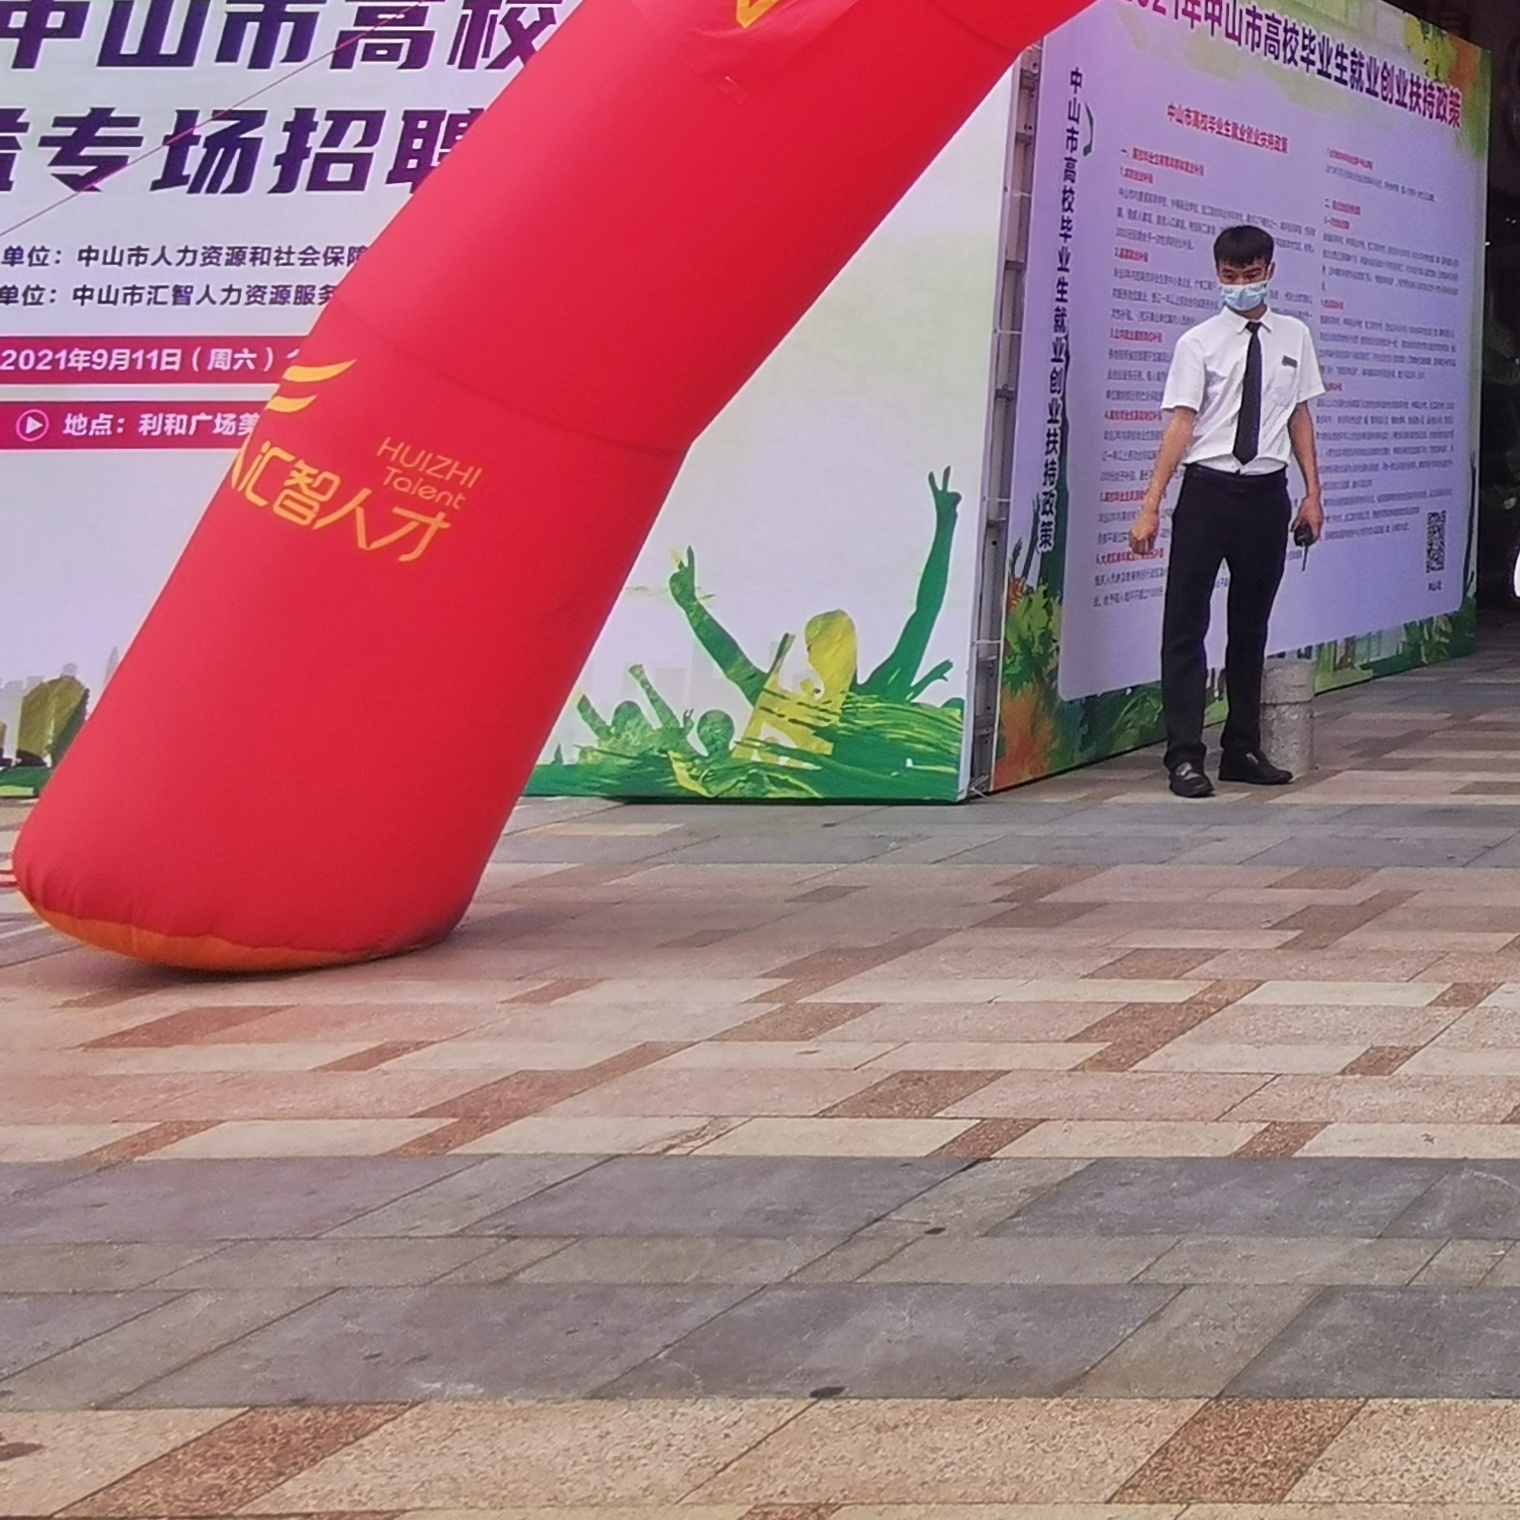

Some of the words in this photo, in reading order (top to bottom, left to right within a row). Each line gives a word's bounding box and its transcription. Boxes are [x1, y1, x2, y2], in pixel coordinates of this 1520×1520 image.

[1037, 66, 1084, 553] 中山市高校毕业生就业创业扶持政策
[236, 440, 451, 563] 汇智人才
[376, 436, 483, 489] HUIZHI
[383, 466, 466, 510] Talent
